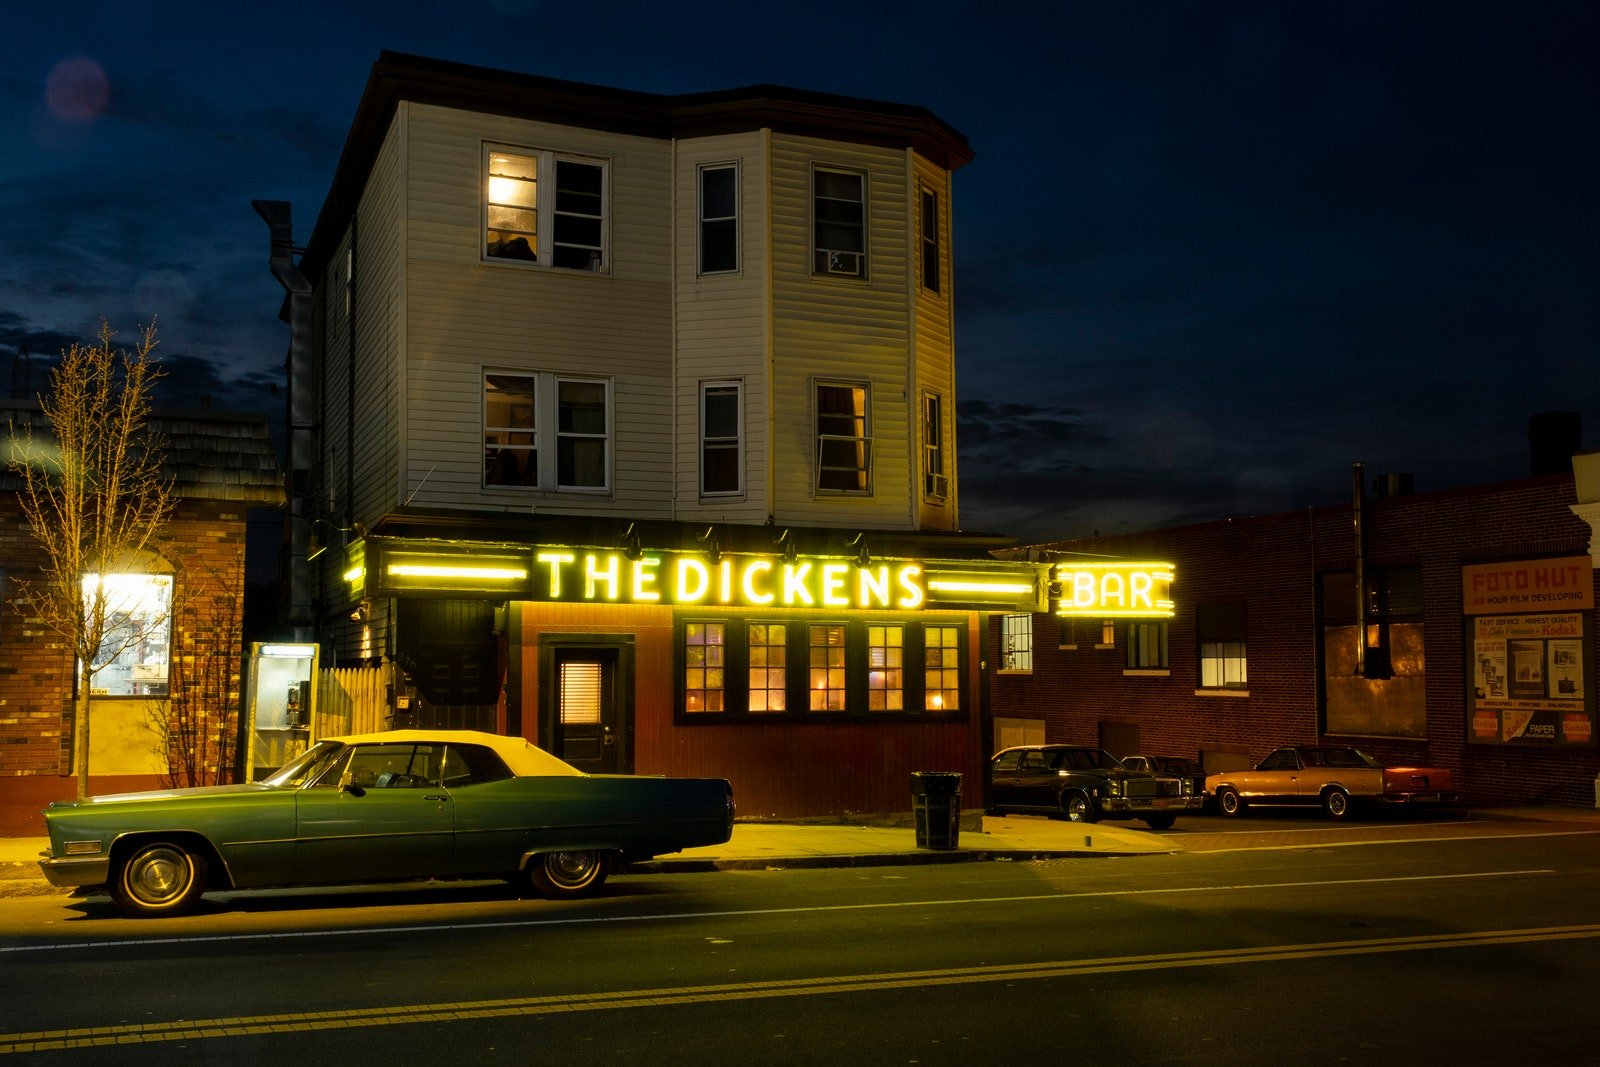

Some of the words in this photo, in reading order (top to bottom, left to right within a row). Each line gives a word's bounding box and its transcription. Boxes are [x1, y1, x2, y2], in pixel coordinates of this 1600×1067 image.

[536, 552, 661, 602] THE
[674, 558, 925, 610] DICKENS
[1472, 569, 1528, 592] FOTO
[1535, 566, 1580, 588] HUT
[1072, 571, 1154, 608] BAR
[1487, 595, 1508, 604] HOUR
[1511, 594, 1529, 603] FILM
[1532, 591, 1583, 602] DEVELOPING
[1496, 618, 1519, 626] SERVICE
[1551, 616, 1577, 624] QUALITY
[1542, 624, 1577, 635] Kodak
[1505, 712, 1531, 738] Kodak
[1530, 724, 1555, 734] PAPER
[1564, 723, 1590, 733] Kodak
